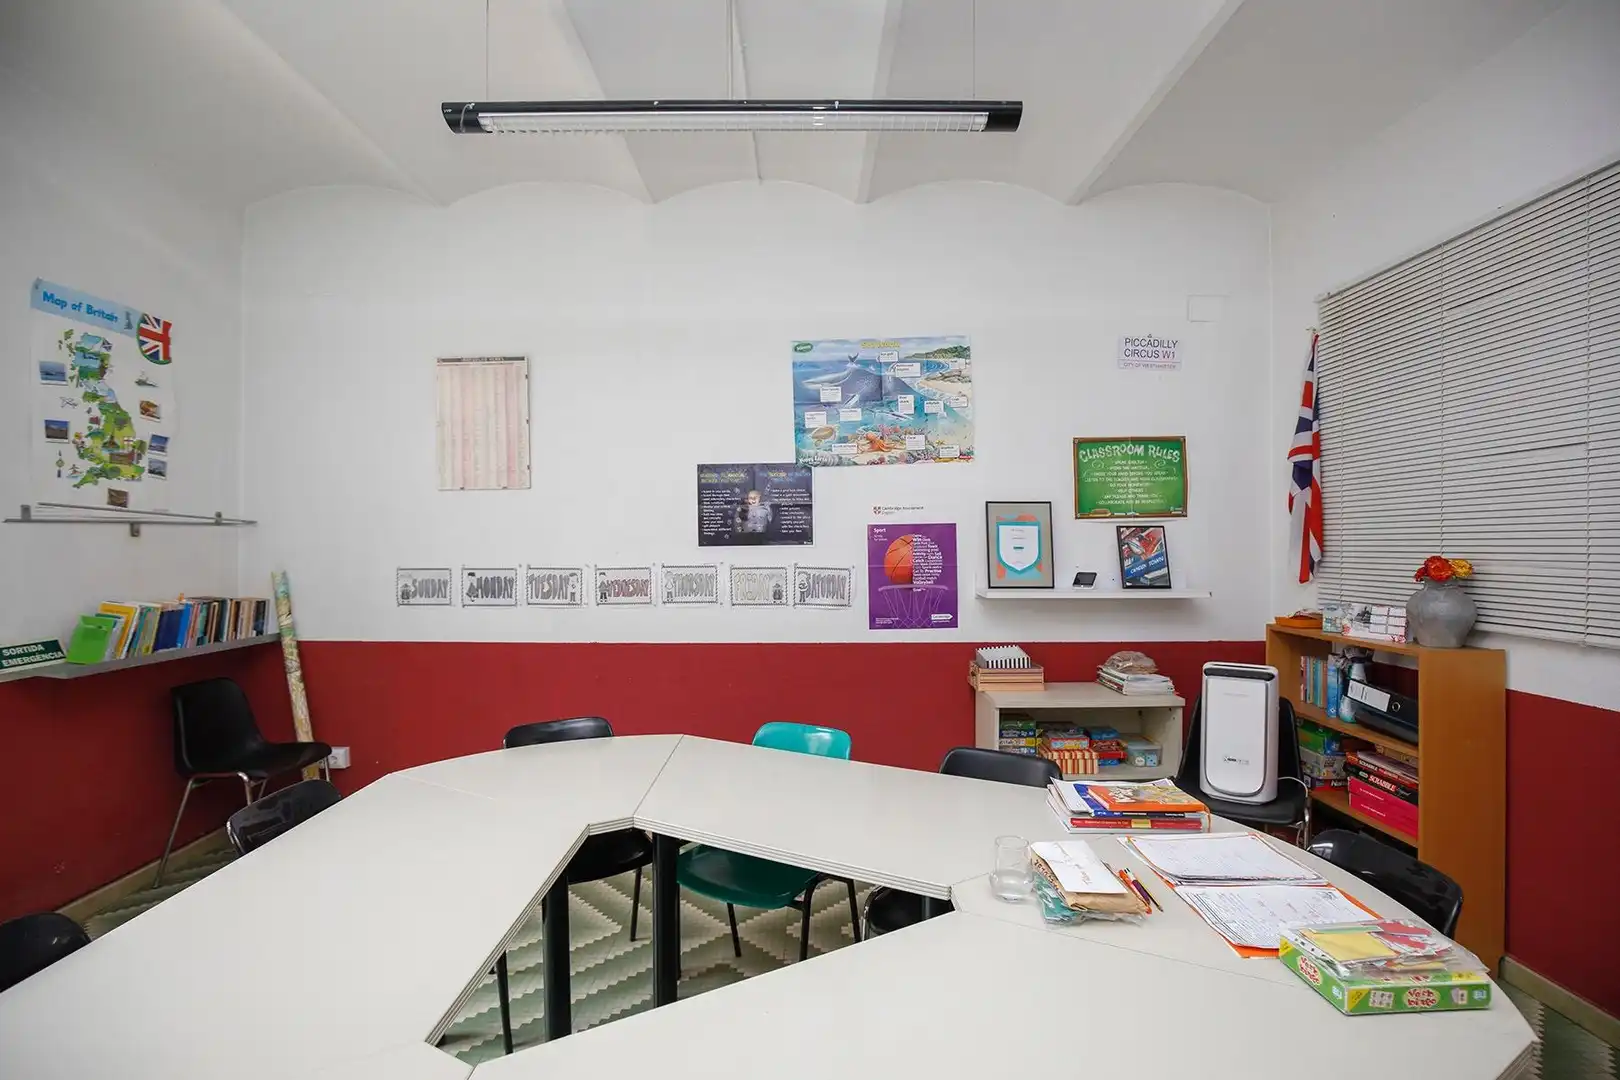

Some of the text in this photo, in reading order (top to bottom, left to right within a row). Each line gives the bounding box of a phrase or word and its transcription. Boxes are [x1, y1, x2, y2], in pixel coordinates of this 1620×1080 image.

[43, 291, 119, 323] Map of Britain
[1124, 337, 1178, 349] PICCADILLY
[1124, 348, 1176, 360] CIRCUS W1
[1079, 443, 1181, 463] CLASSROOM RULES
[1148, 556, 1164, 567] TOWN
[411, 578, 448, 599] SUNDAY
[476, 576, 514, 599] MONDAY
[528, 573, 570, 600] TUESDAY
[607, 579, 649, 598] WEDNESDAY
[674, 572, 715, 597] THURSDAY
[805, 573, 847, 600] SATURDAY
[2, 644, 45, 657] SORTIDA
[1368, 775, 1397, 792] SCRABBLE
